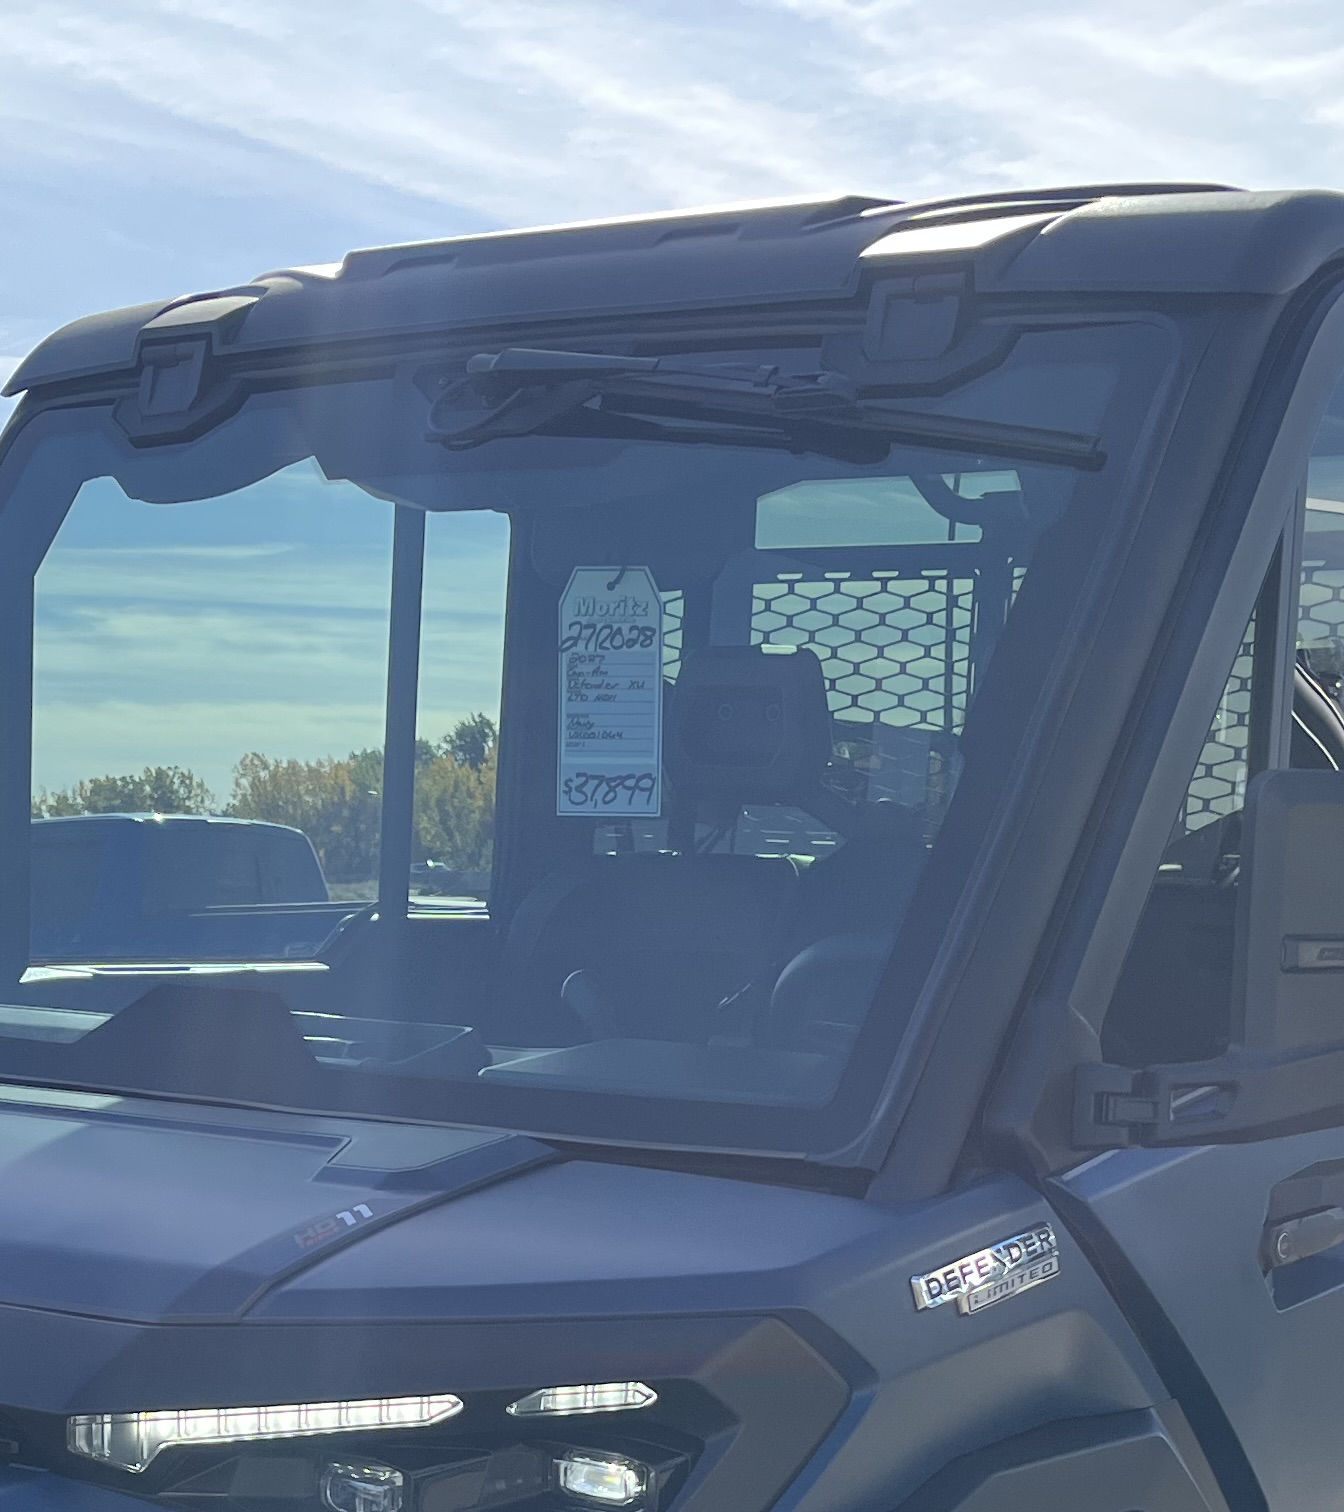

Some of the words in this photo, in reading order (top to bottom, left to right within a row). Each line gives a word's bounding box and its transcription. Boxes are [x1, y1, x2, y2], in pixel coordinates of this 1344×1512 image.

[573, 595, 649, 617] Moritz
[562, 771, 656, 809] $37,899
[925, 1229, 1054, 1300] DEFENDER
